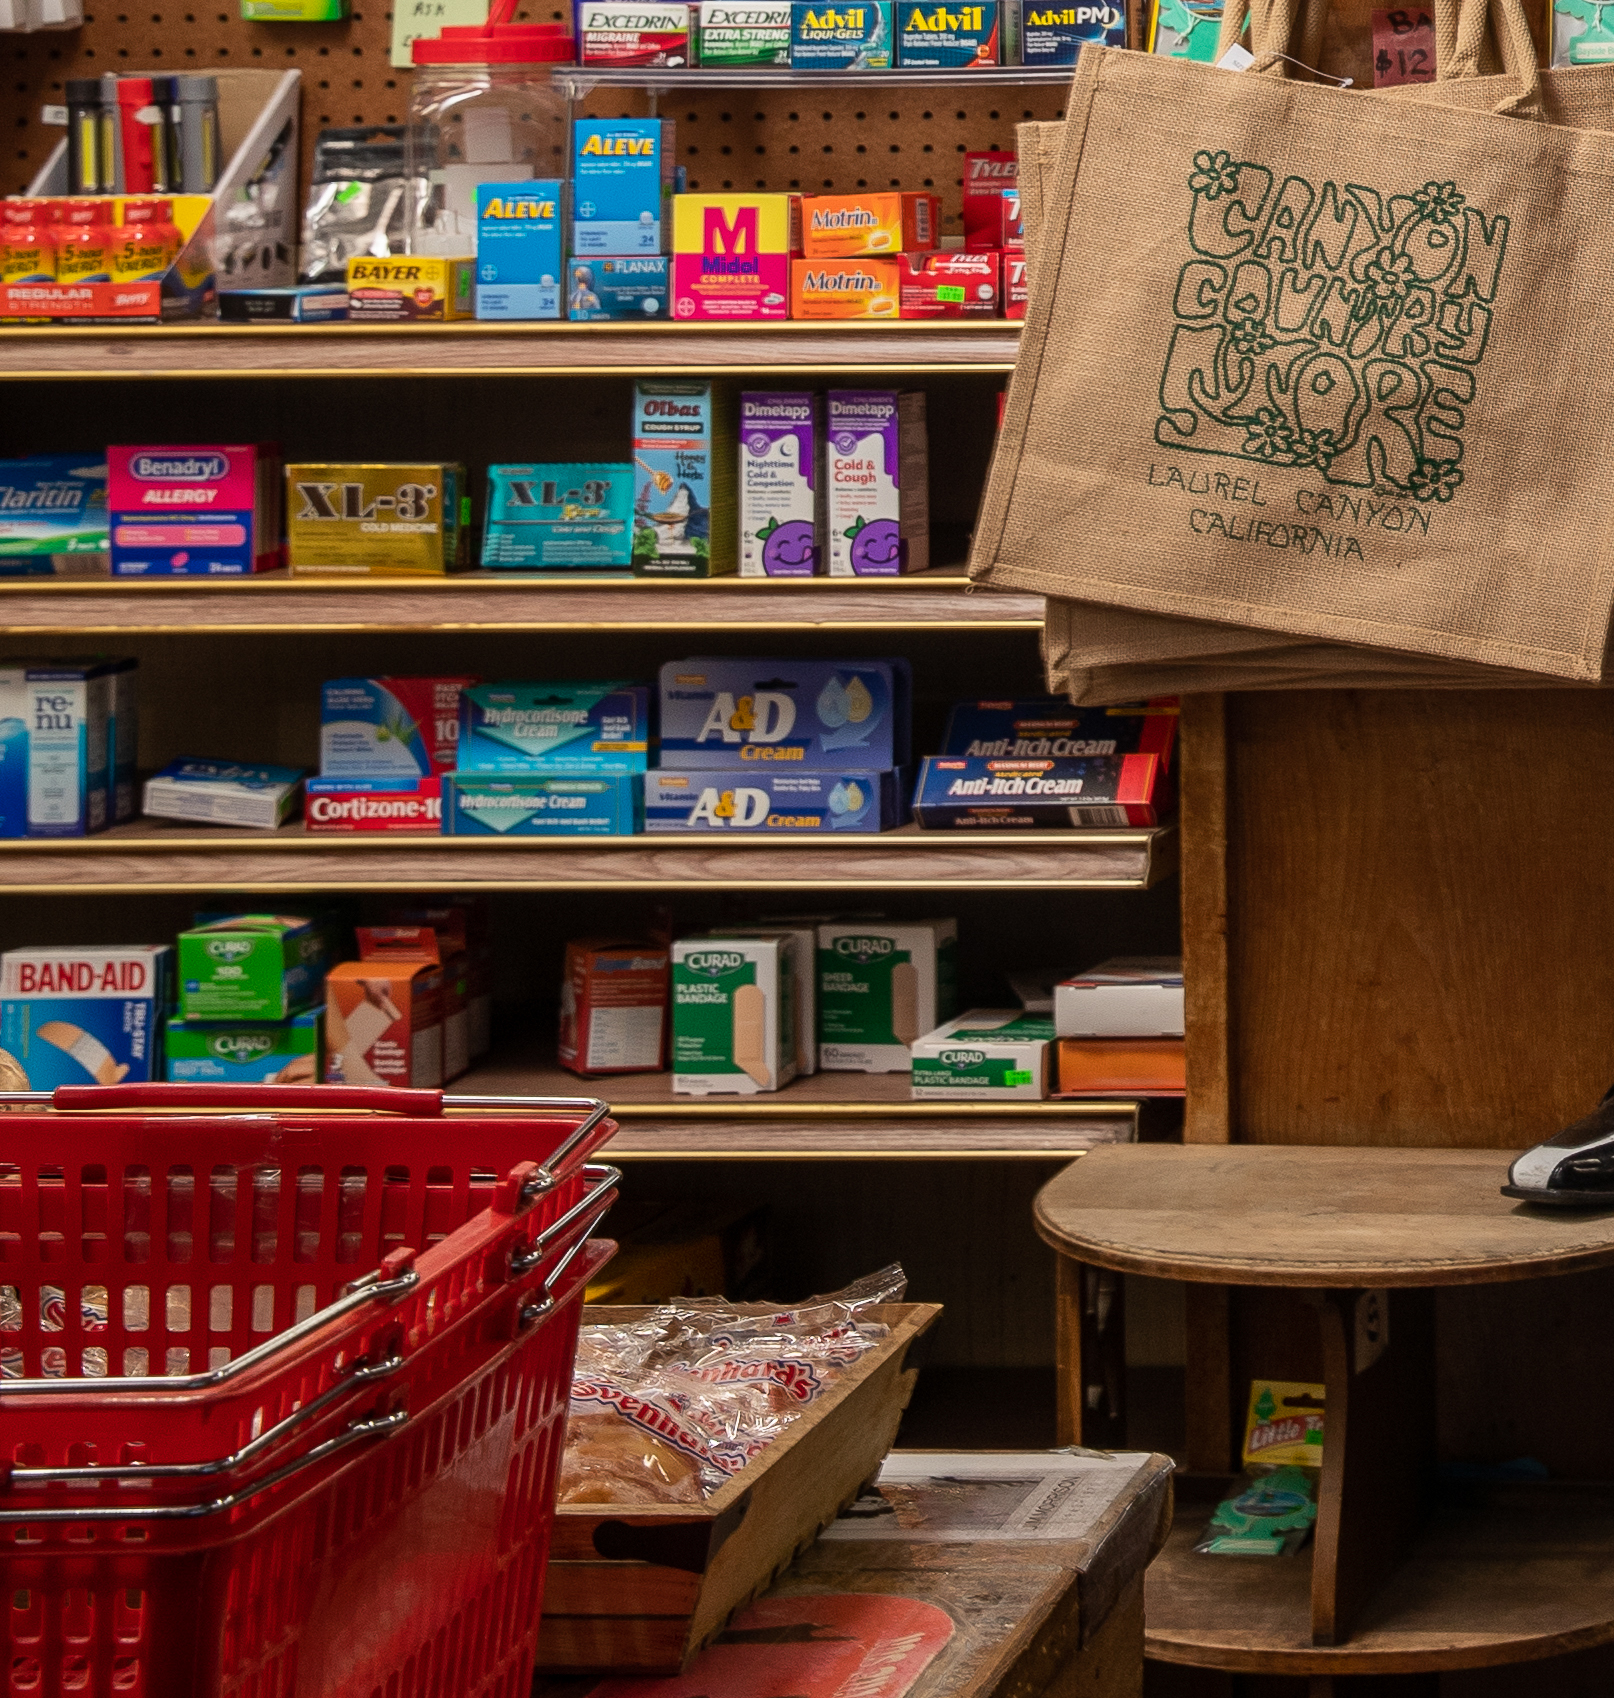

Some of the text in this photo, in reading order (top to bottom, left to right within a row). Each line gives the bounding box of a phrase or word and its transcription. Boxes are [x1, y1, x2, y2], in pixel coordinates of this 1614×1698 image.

[588, 12, 681, 29] EXCEDRIN
[801, 10, 866, 30] Advil
[905, 8, 984, 32] Advil
[1027, 6, 1110, 25] Advil PM
[586, 32, 641, 43] MIGRAINE
[705, 29, 736, 40] EXTRA
[580, 135, 655, 157] ALEVE
[483, 198, 556, 219] ALEVE
[811, 209, 872, 230] Motrin
[1189, 151, 1509, 303] CANYON
[703, 207, 760, 253] M
[351, 265, 421, 282] BAYER
[615, 260, 665, 274] FLANAX
[703, 257, 760, 275] Midol
[804, 272, 873, 292] Motrin
[644, 400, 700, 417] Olbas
[744, 403, 809, 420] Dimetapp
[832, 402, 894, 419] Dimetapp
[140, 457, 219, 480] Benadryl
[834, 460, 863, 471] Cold
[834, 472, 877, 485] Cough
[143, 489, 218, 504] ALLERGY
[1149, 464, 1432, 536] LAUREL CANYON
[1189, 508, 1364, 562] CALIFORNIA
[483, 707, 588, 726] Hydrocortisone
[697, 691, 796, 744] A&D
[514, 722, 558, 739] Cream
[741, 744, 805, 762] Cream
[1025, 777, 1083, 794] Cream
[548, 793, 586, 809] Cream
[687, 786, 770, 827] A&D
[767, 813, 821, 829] Cream
[836, 938, 894, 956] CURAD
[689, 953, 740, 970] CURAD
[19, 962, 146, 992] BAND-AID
[676, 984, 719, 995] PLASTIC
[677, 993, 728, 1004] BANDAGE
[213, 1035, 272, 1054] CURAD
[941, 1051, 983, 1065] CURAD
